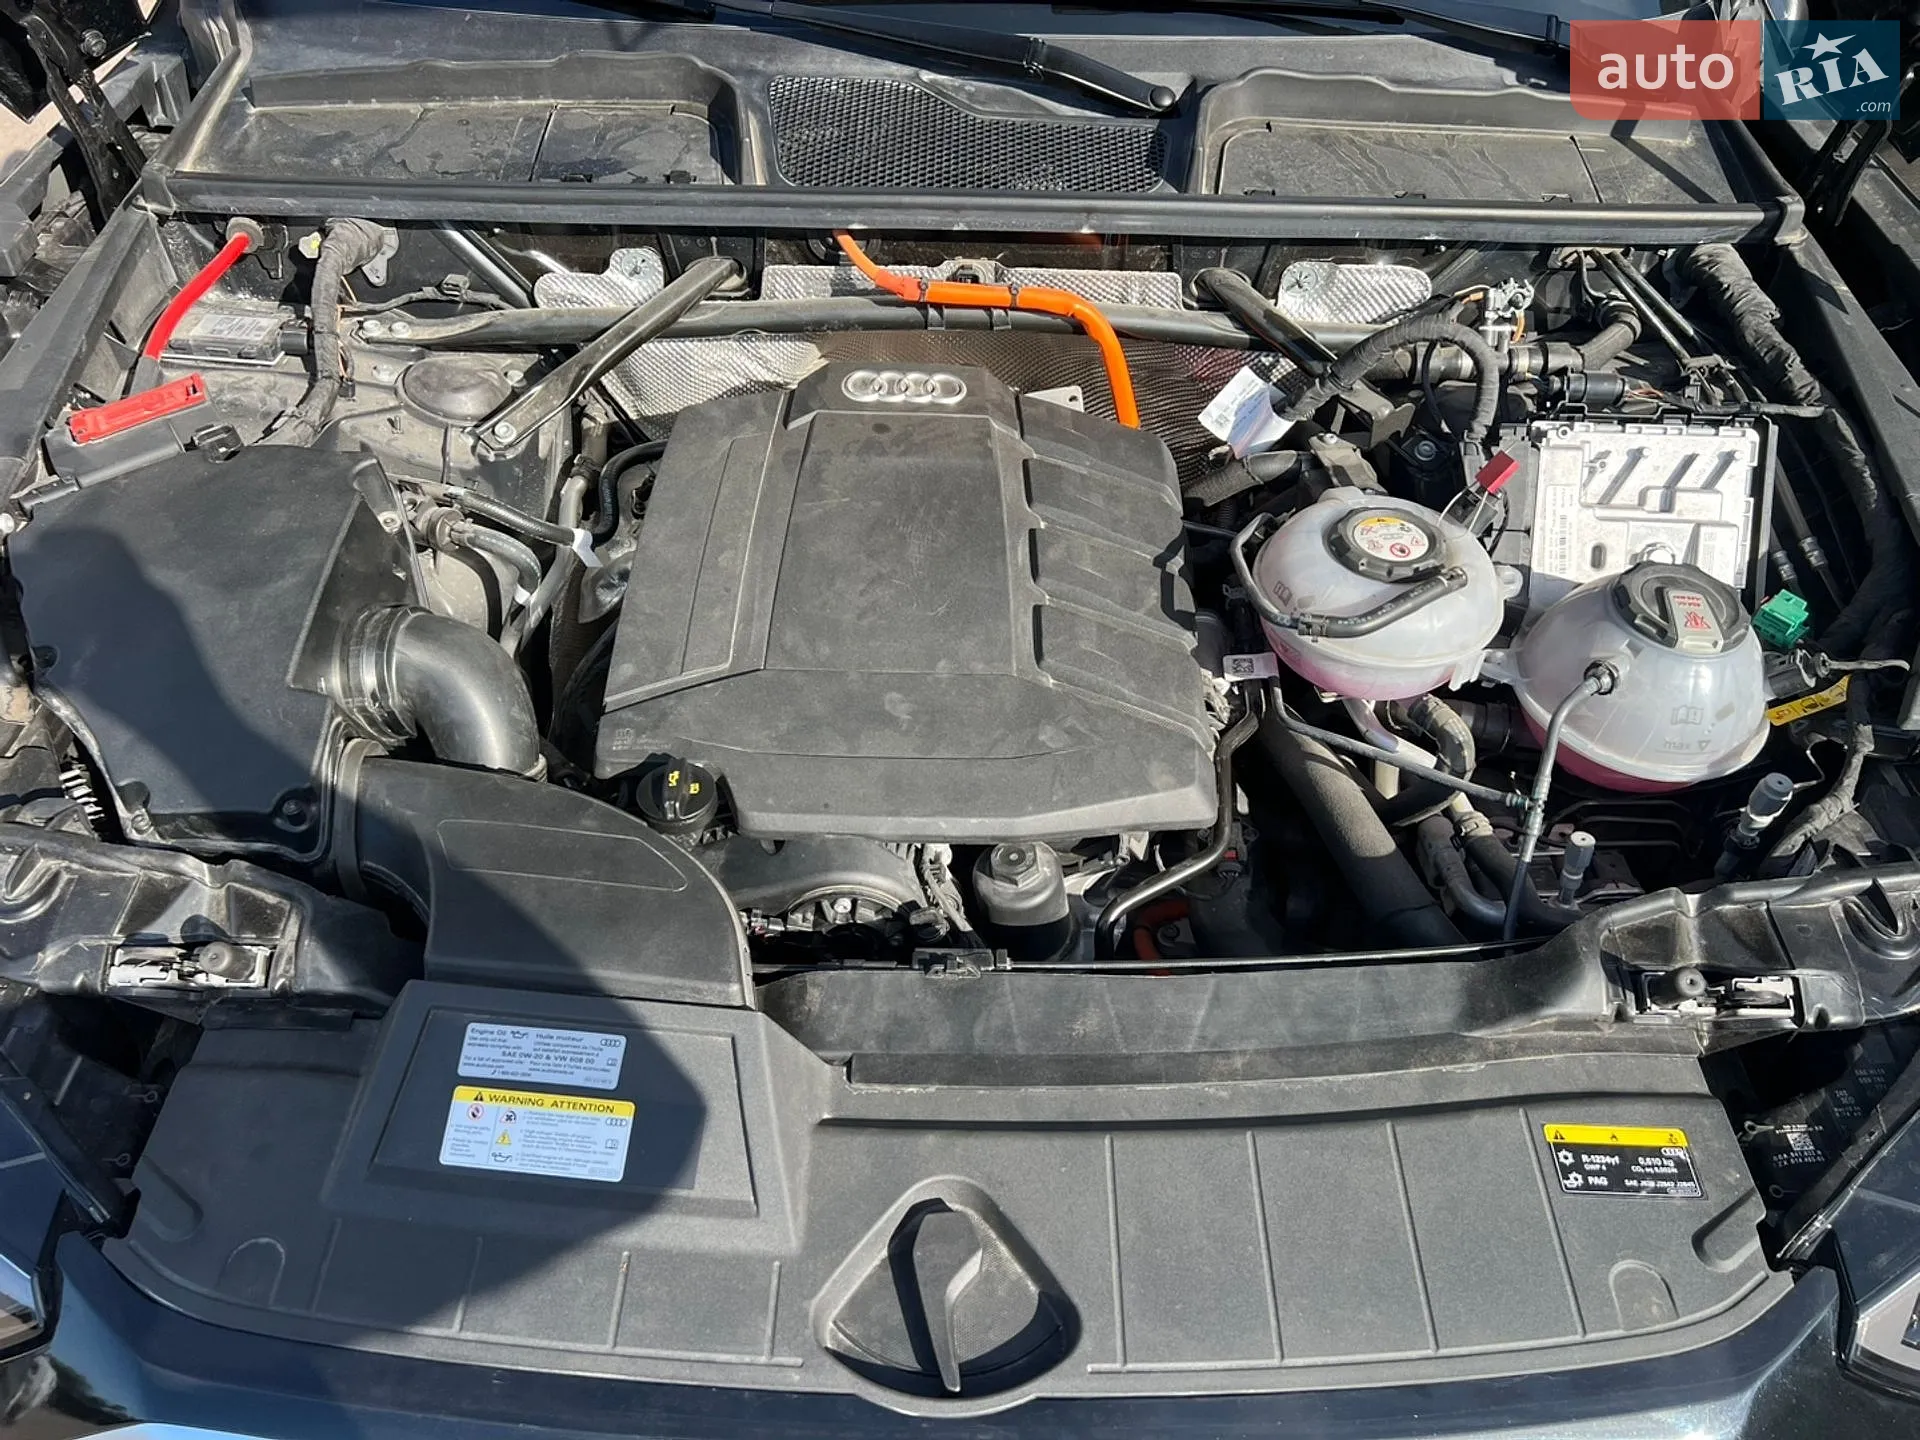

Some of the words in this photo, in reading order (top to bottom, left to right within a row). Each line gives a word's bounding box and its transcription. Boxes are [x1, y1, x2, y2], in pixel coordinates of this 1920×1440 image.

[488, 1093, 544, 1107] WARNING
[550, 1100, 615, 1114] ATTENTION
[1587, 1175, 1608, 1186] PAG
